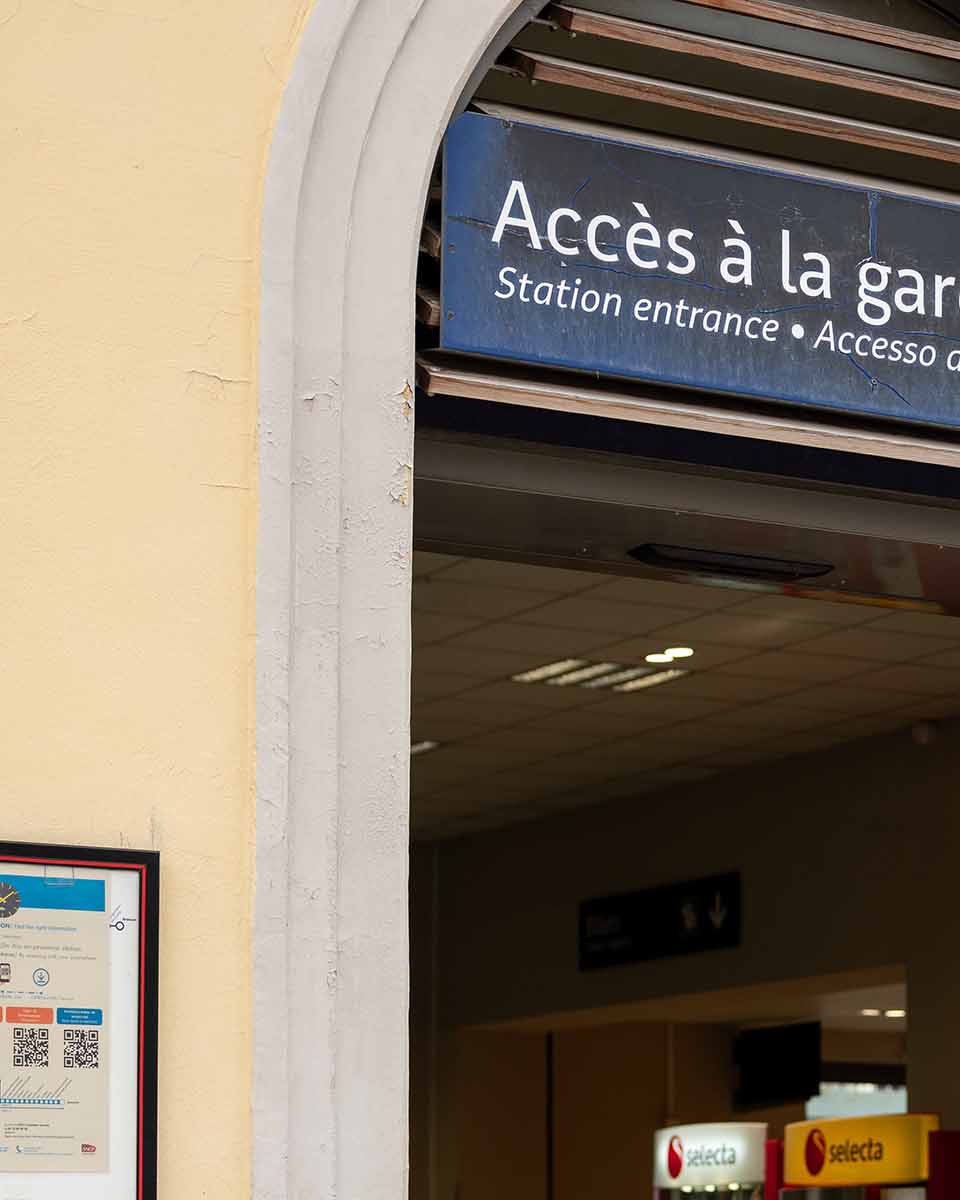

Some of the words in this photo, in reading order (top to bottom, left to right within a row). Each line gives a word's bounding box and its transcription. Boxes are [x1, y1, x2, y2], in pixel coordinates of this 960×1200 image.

[491, 180, 696, 275] Accès
[720, 219, 753, 287] à
[782, 229, 832, 299] la
[494, 266, 622, 317] Station
[633, 298, 780, 342] entrance
[813, 319, 937, 367] Accesso
[686, 1143, 737, 1167] selecta
[828, 1138, 884, 1164] selecta
